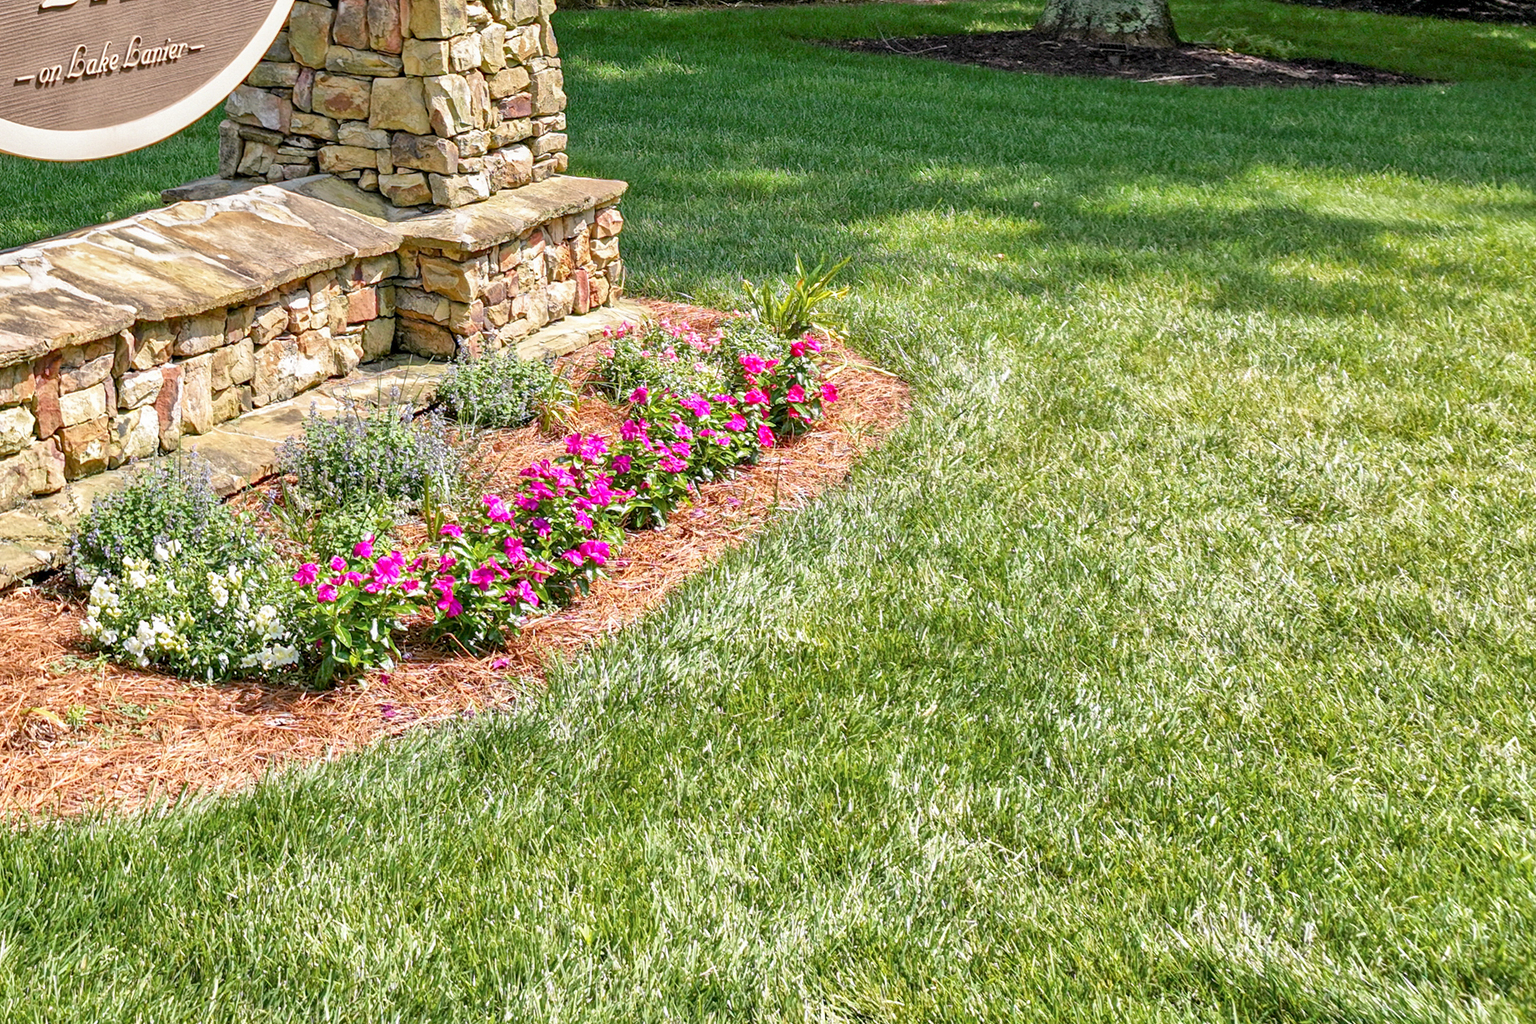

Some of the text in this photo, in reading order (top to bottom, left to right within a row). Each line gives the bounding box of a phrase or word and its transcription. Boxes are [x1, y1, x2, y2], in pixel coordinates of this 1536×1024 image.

[38, 34, 189, 84] on Lake Lanier
